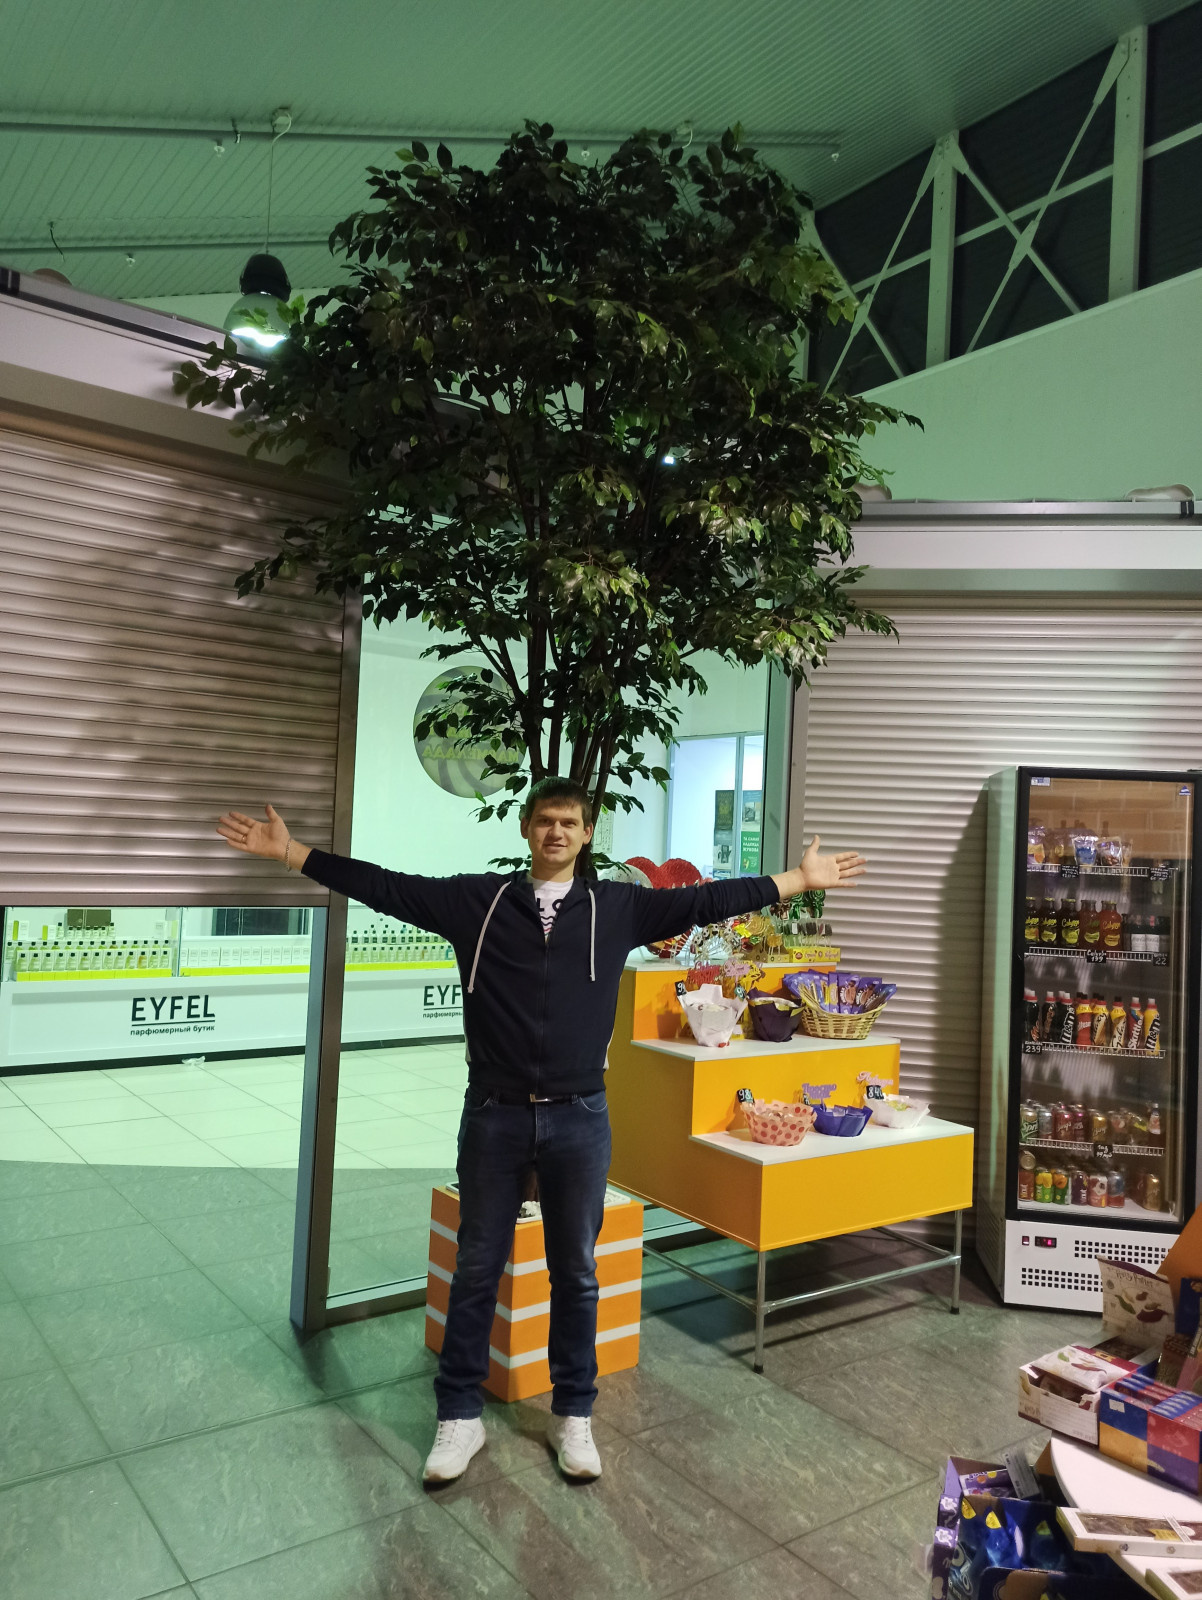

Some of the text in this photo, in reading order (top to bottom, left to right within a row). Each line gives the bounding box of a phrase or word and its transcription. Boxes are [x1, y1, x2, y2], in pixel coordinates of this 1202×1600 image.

[131, 994, 216, 1021] EYFEL
[130, 1024, 215, 1037] парфюмерный бутик
